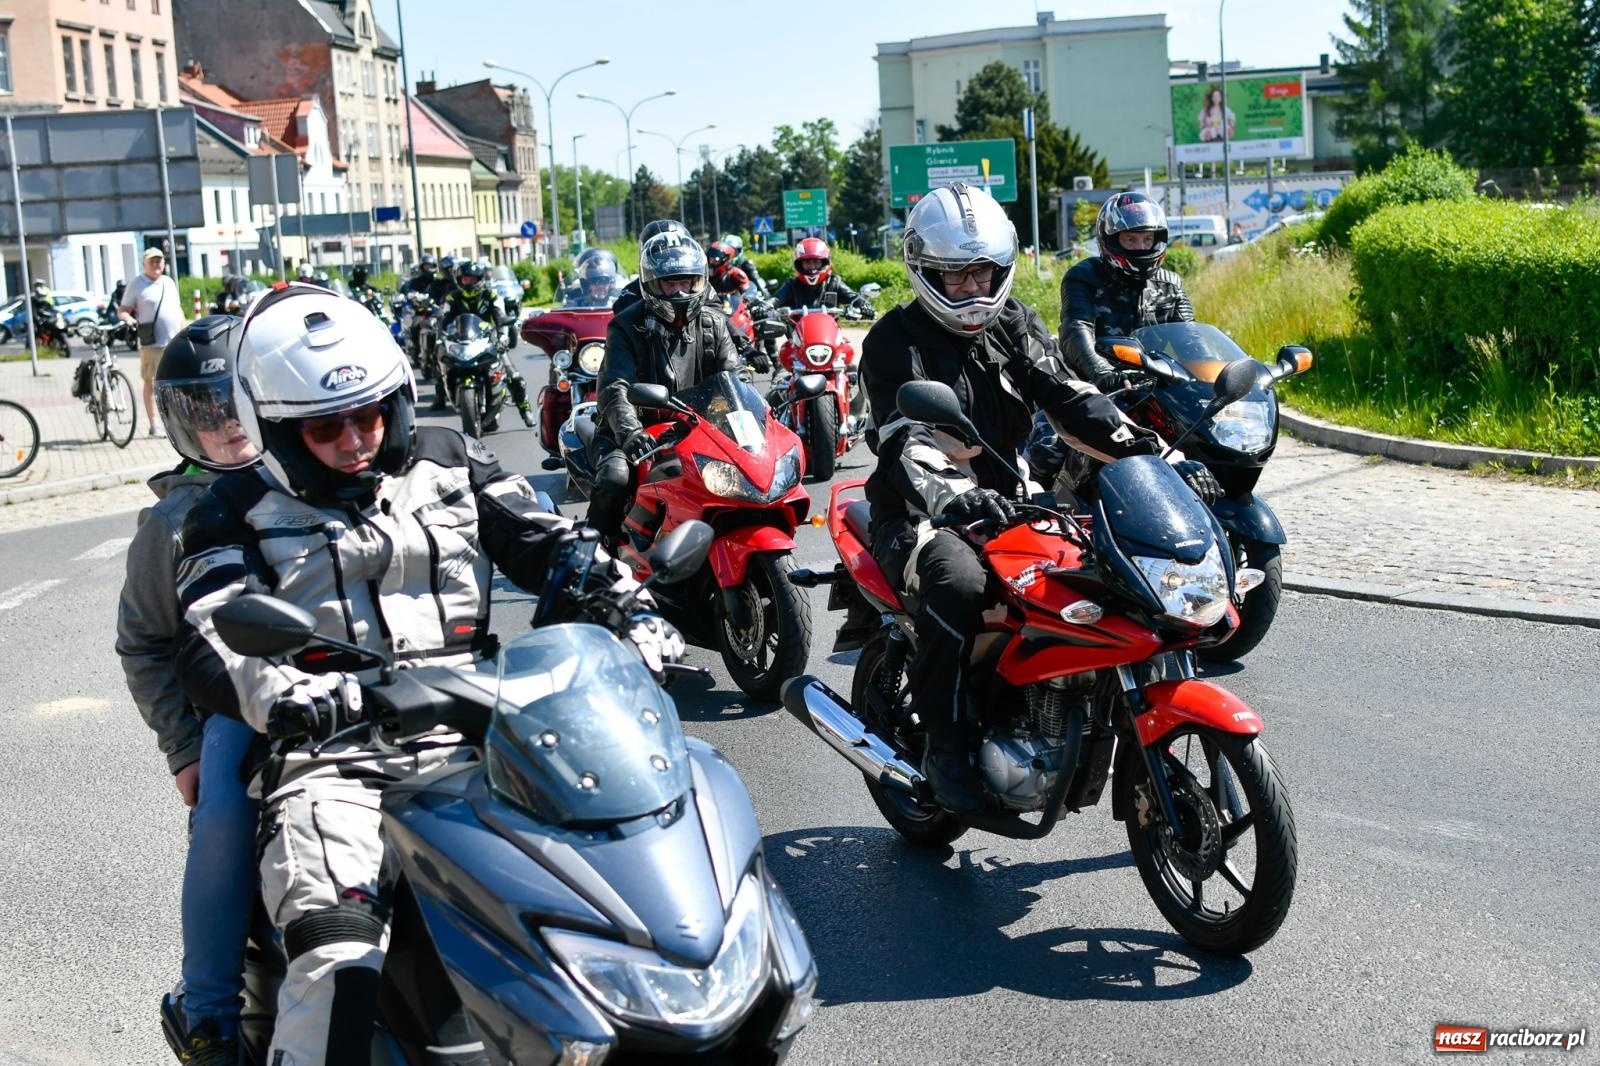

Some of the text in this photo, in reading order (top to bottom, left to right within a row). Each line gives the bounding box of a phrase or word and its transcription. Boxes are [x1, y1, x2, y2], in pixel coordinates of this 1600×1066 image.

[926, 147, 954, 155] Rybnik
[200, 358, 225, 374] LZR
[326, 366, 367, 388] Airoh
[1175, 540, 1205, 548] HONDA
